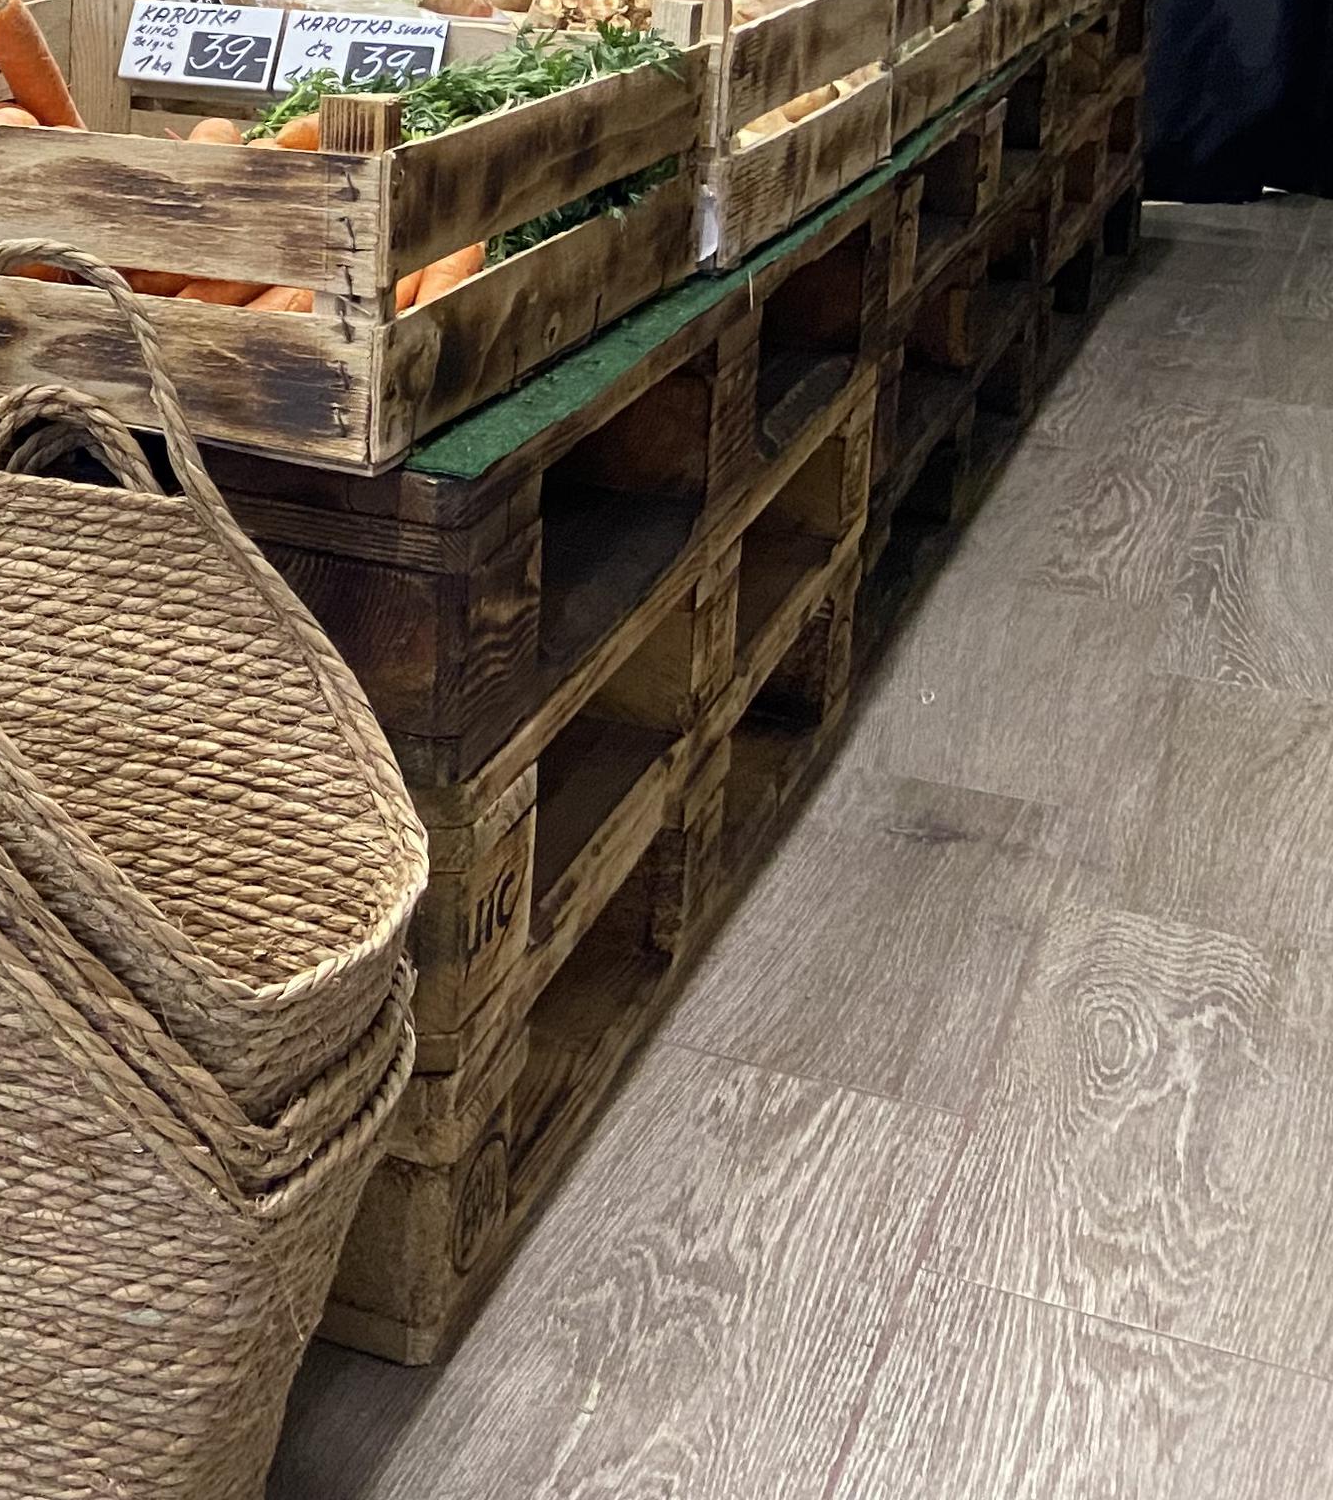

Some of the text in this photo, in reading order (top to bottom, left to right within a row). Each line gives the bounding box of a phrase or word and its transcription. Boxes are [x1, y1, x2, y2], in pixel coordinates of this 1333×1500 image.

[138, 4, 242, 26] KAROTKA
[293, 14, 392, 35] KAROTKA
[189, 33, 268, 80] 39,-
[305, 39, 333, 60] ČR
